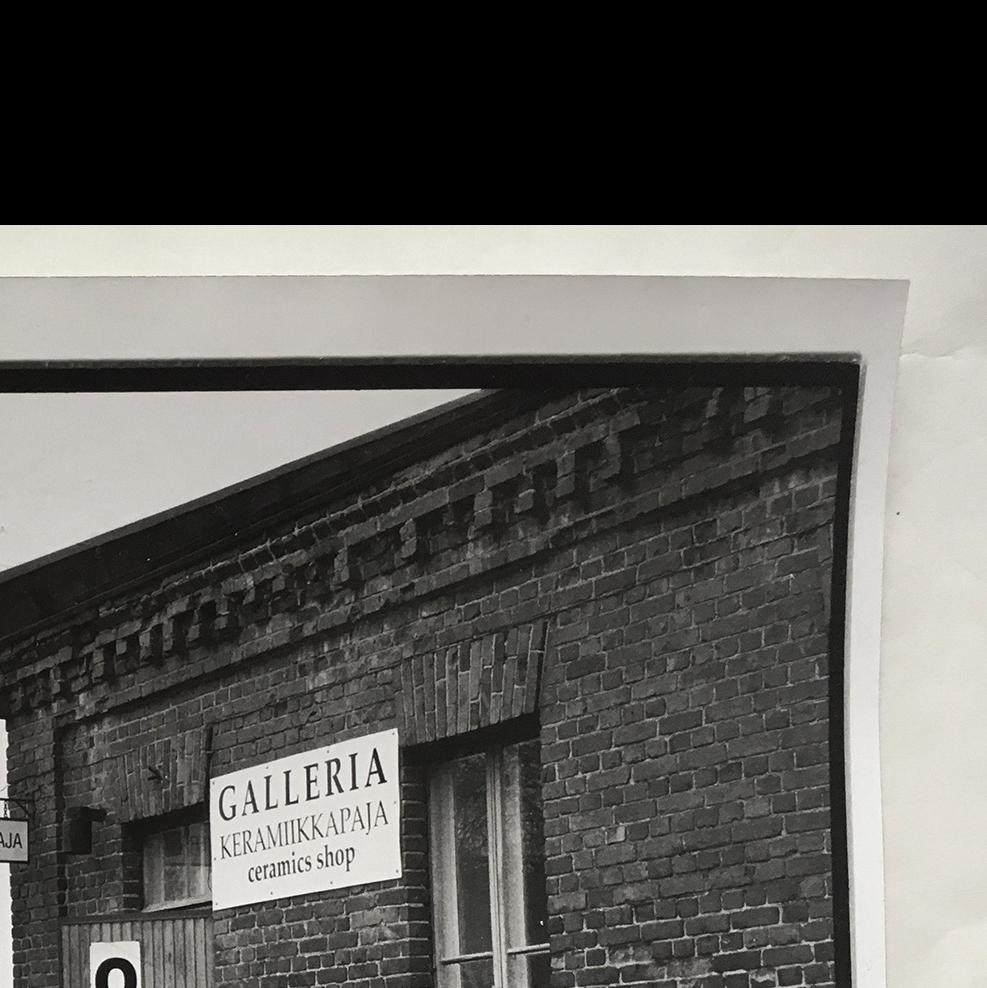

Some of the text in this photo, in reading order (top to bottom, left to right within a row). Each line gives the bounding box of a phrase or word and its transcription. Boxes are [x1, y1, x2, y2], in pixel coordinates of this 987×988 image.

[218, 747, 388, 821] GALLERIA
[219, 800, 389, 860] KERAMIIKKAPAJA
[247, 844, 356, 882] ceramics shop
